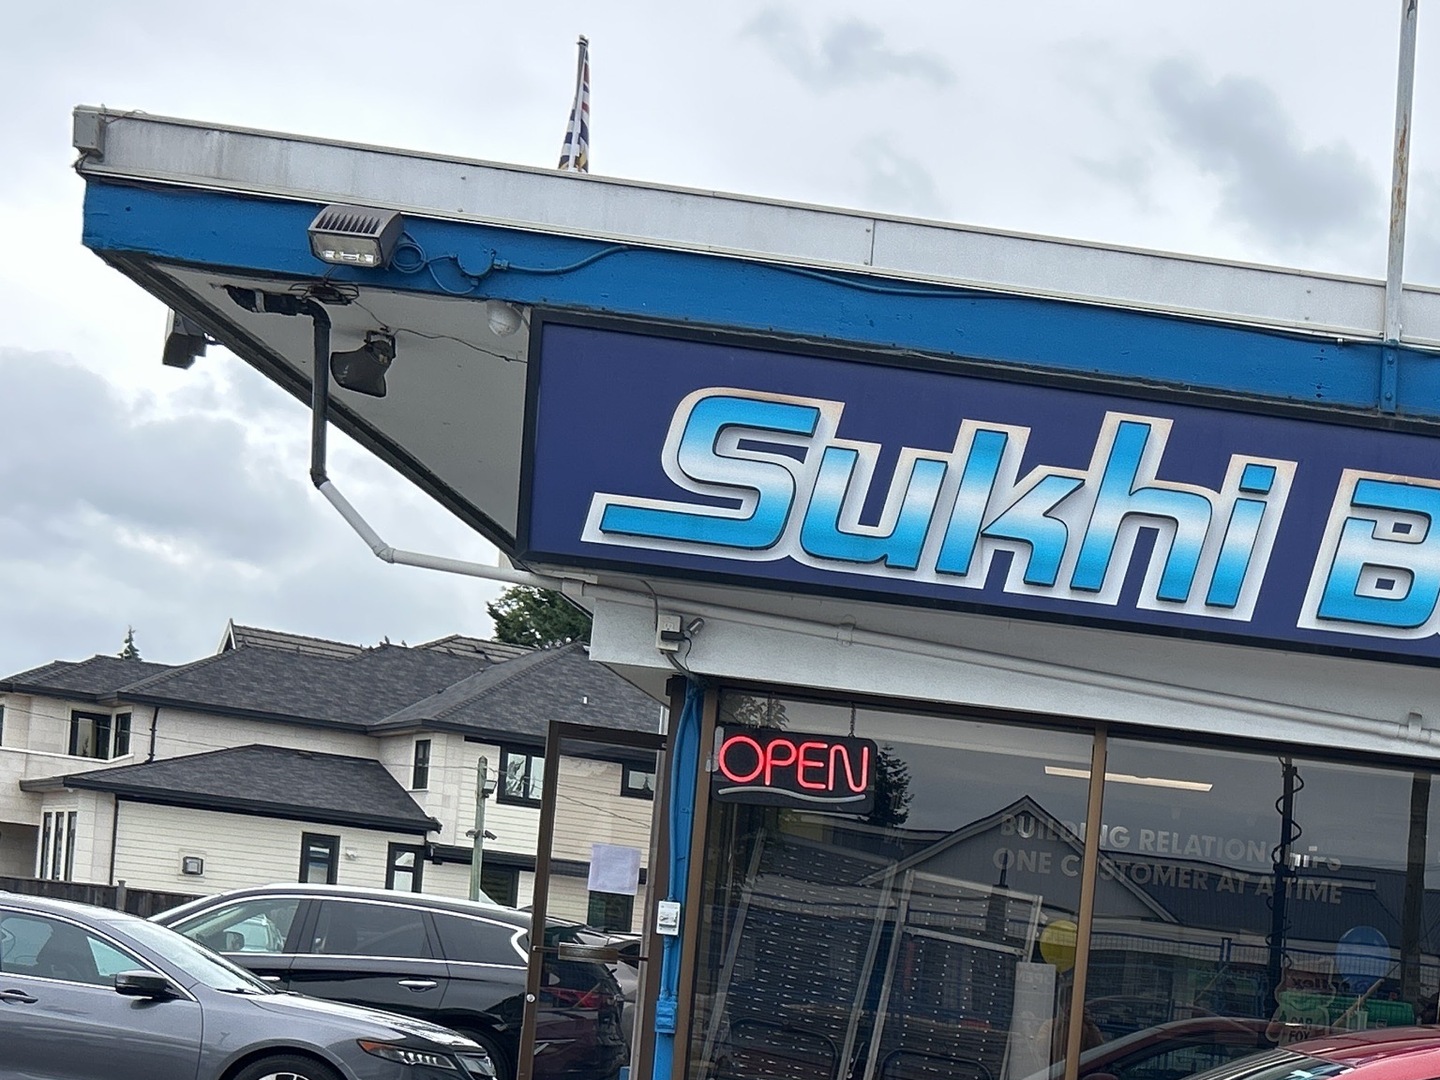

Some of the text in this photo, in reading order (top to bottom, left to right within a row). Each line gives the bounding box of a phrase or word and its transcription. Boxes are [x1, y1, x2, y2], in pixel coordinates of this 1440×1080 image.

[580, 386, 1298, 622] Sukhi
[718, 735, 869, 793] OPEN
[992, 847, 1052, 874] ONE
[1060, 854, 1209, 890] CSTOMER
[1216, 870, 1251, 894] AT
[1281, 876, 1344, 904] TIME
[1139, 828, 1342, 872] RELATIONHIS
